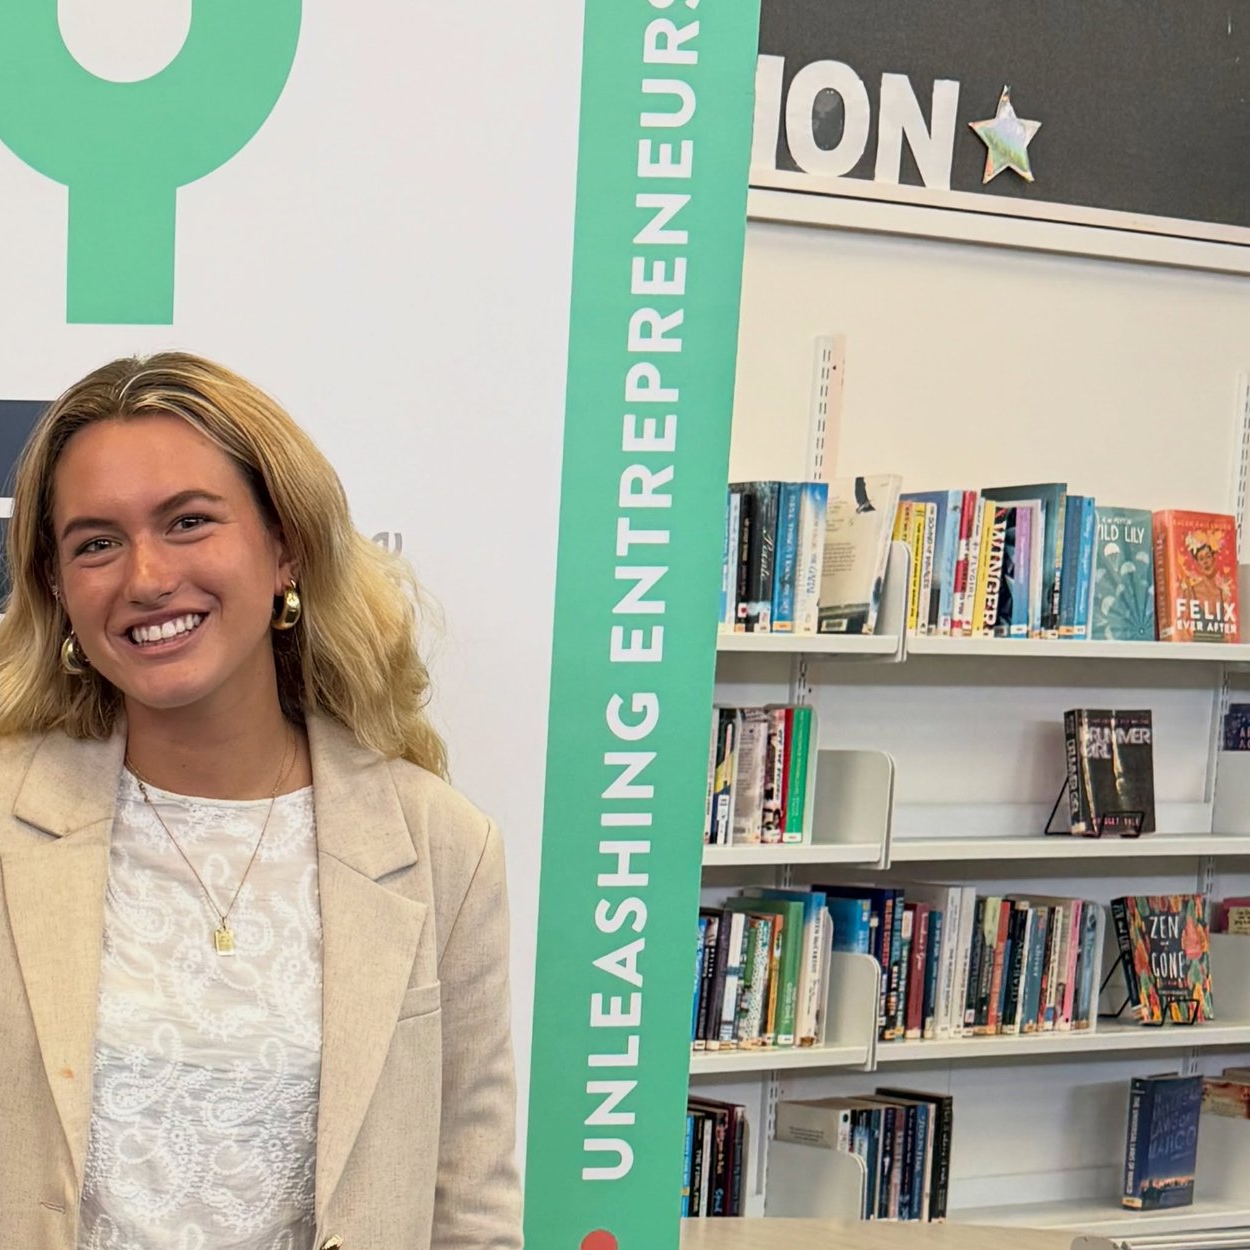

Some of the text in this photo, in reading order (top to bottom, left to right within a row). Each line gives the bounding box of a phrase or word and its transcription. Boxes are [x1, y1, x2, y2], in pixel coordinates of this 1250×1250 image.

[751, 54, 960, 190] ION
[1125, 526, 1145, 544] LILY
[983, 520, 1006, 628] WINGER
[1176, 598, 1236, 622] FELIX
[1177, 618, 1238, 634] EVER AFTER
[582, 692, 659, 1180] UNLEASHING
[1150, 915, 1179, 939] ZEN
[1151, 952, 1185, 979] GONE
